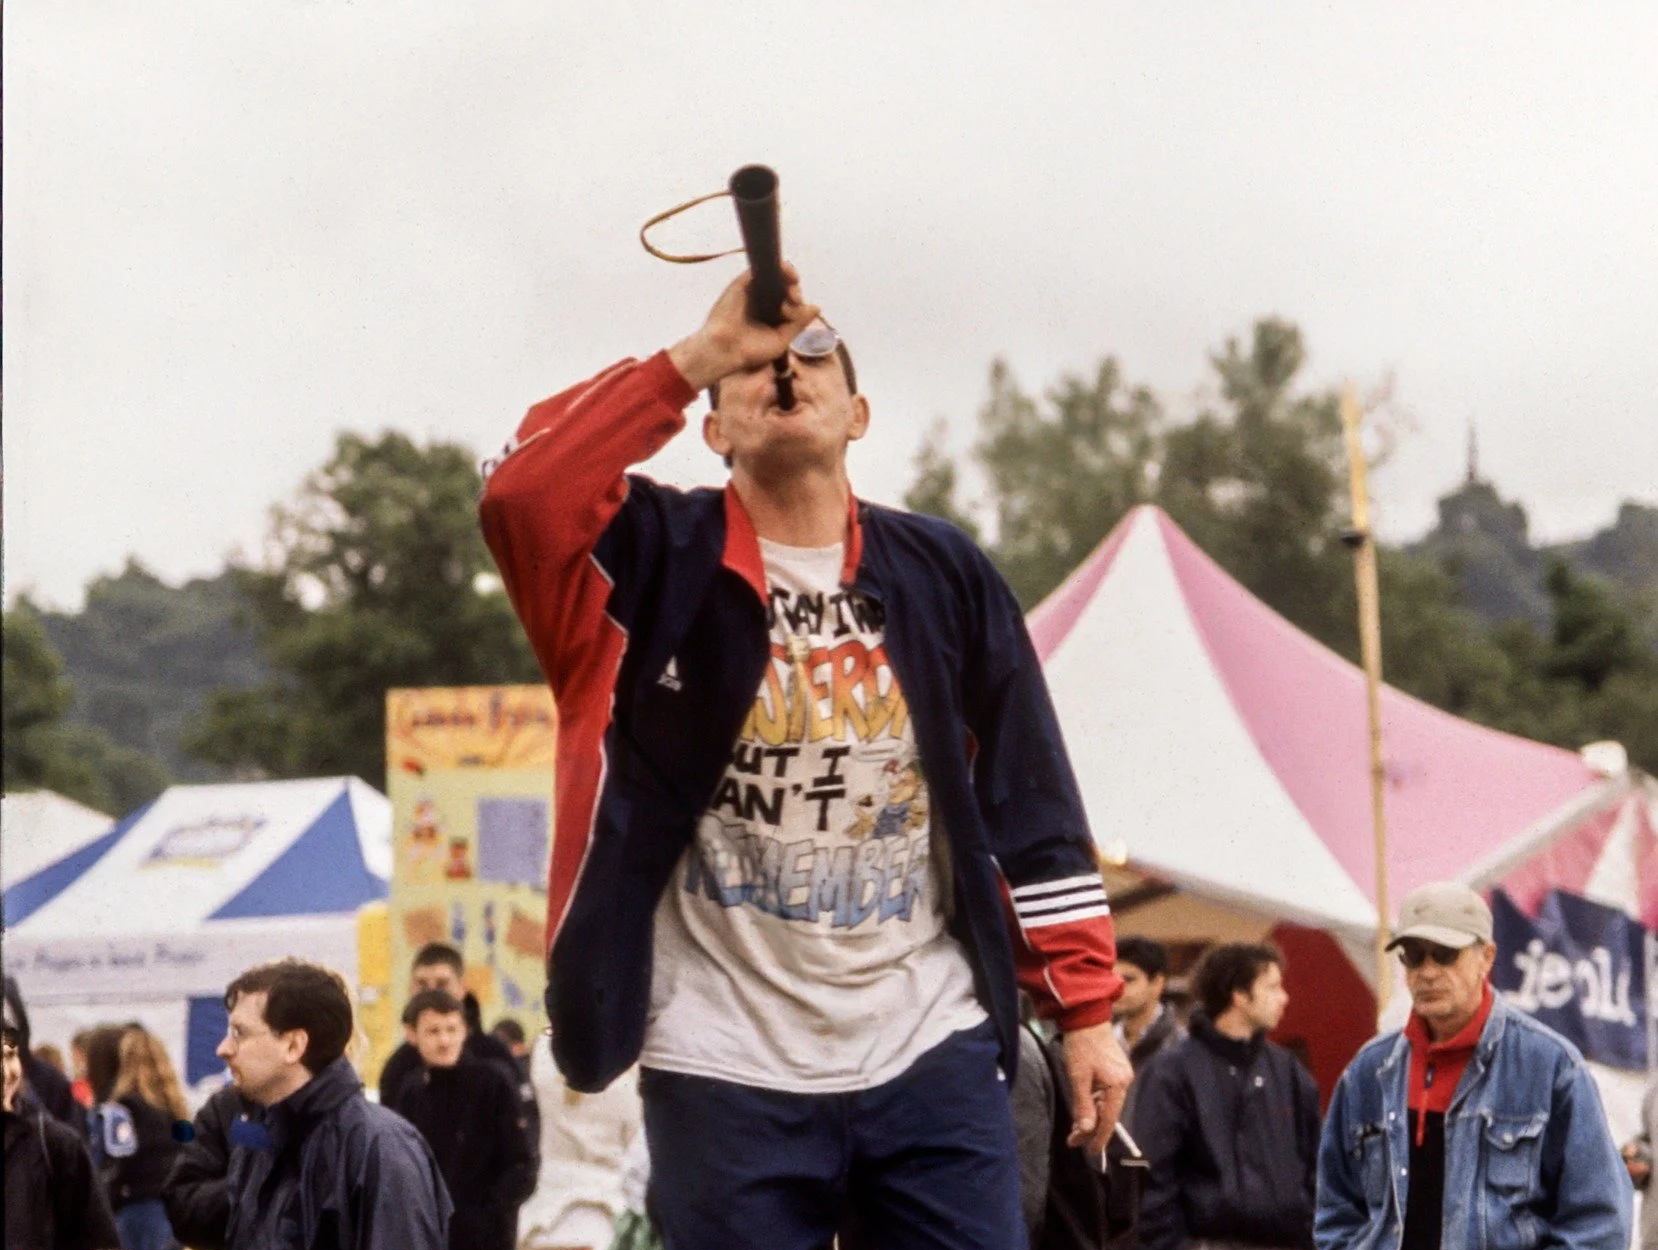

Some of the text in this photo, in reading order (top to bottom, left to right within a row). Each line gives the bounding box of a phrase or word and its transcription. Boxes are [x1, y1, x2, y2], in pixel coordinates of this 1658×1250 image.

[734, 743, 853, 788] UT I
[710, 776, 847, 832] AN'T
